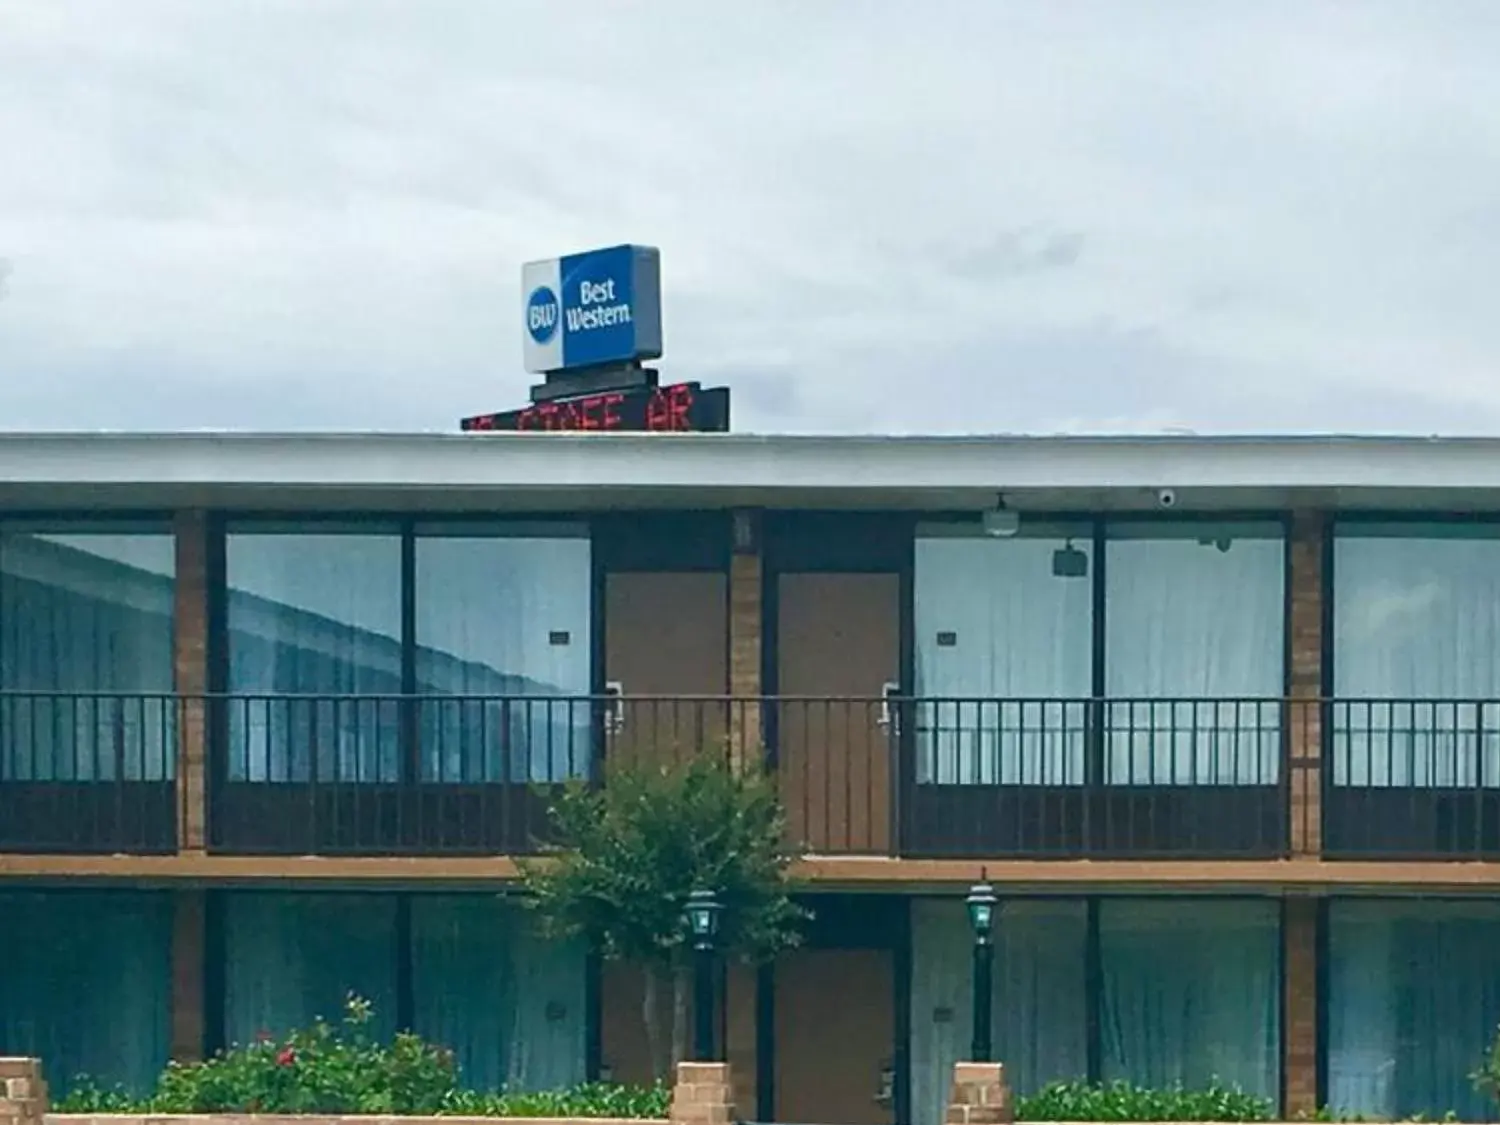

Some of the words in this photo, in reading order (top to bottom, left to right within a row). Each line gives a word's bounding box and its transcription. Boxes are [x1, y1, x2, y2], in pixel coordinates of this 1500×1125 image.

[581, 278, 615, 305] Best
[530, 303, 557, 330] BW
[566, 304, 632, 333] Western
